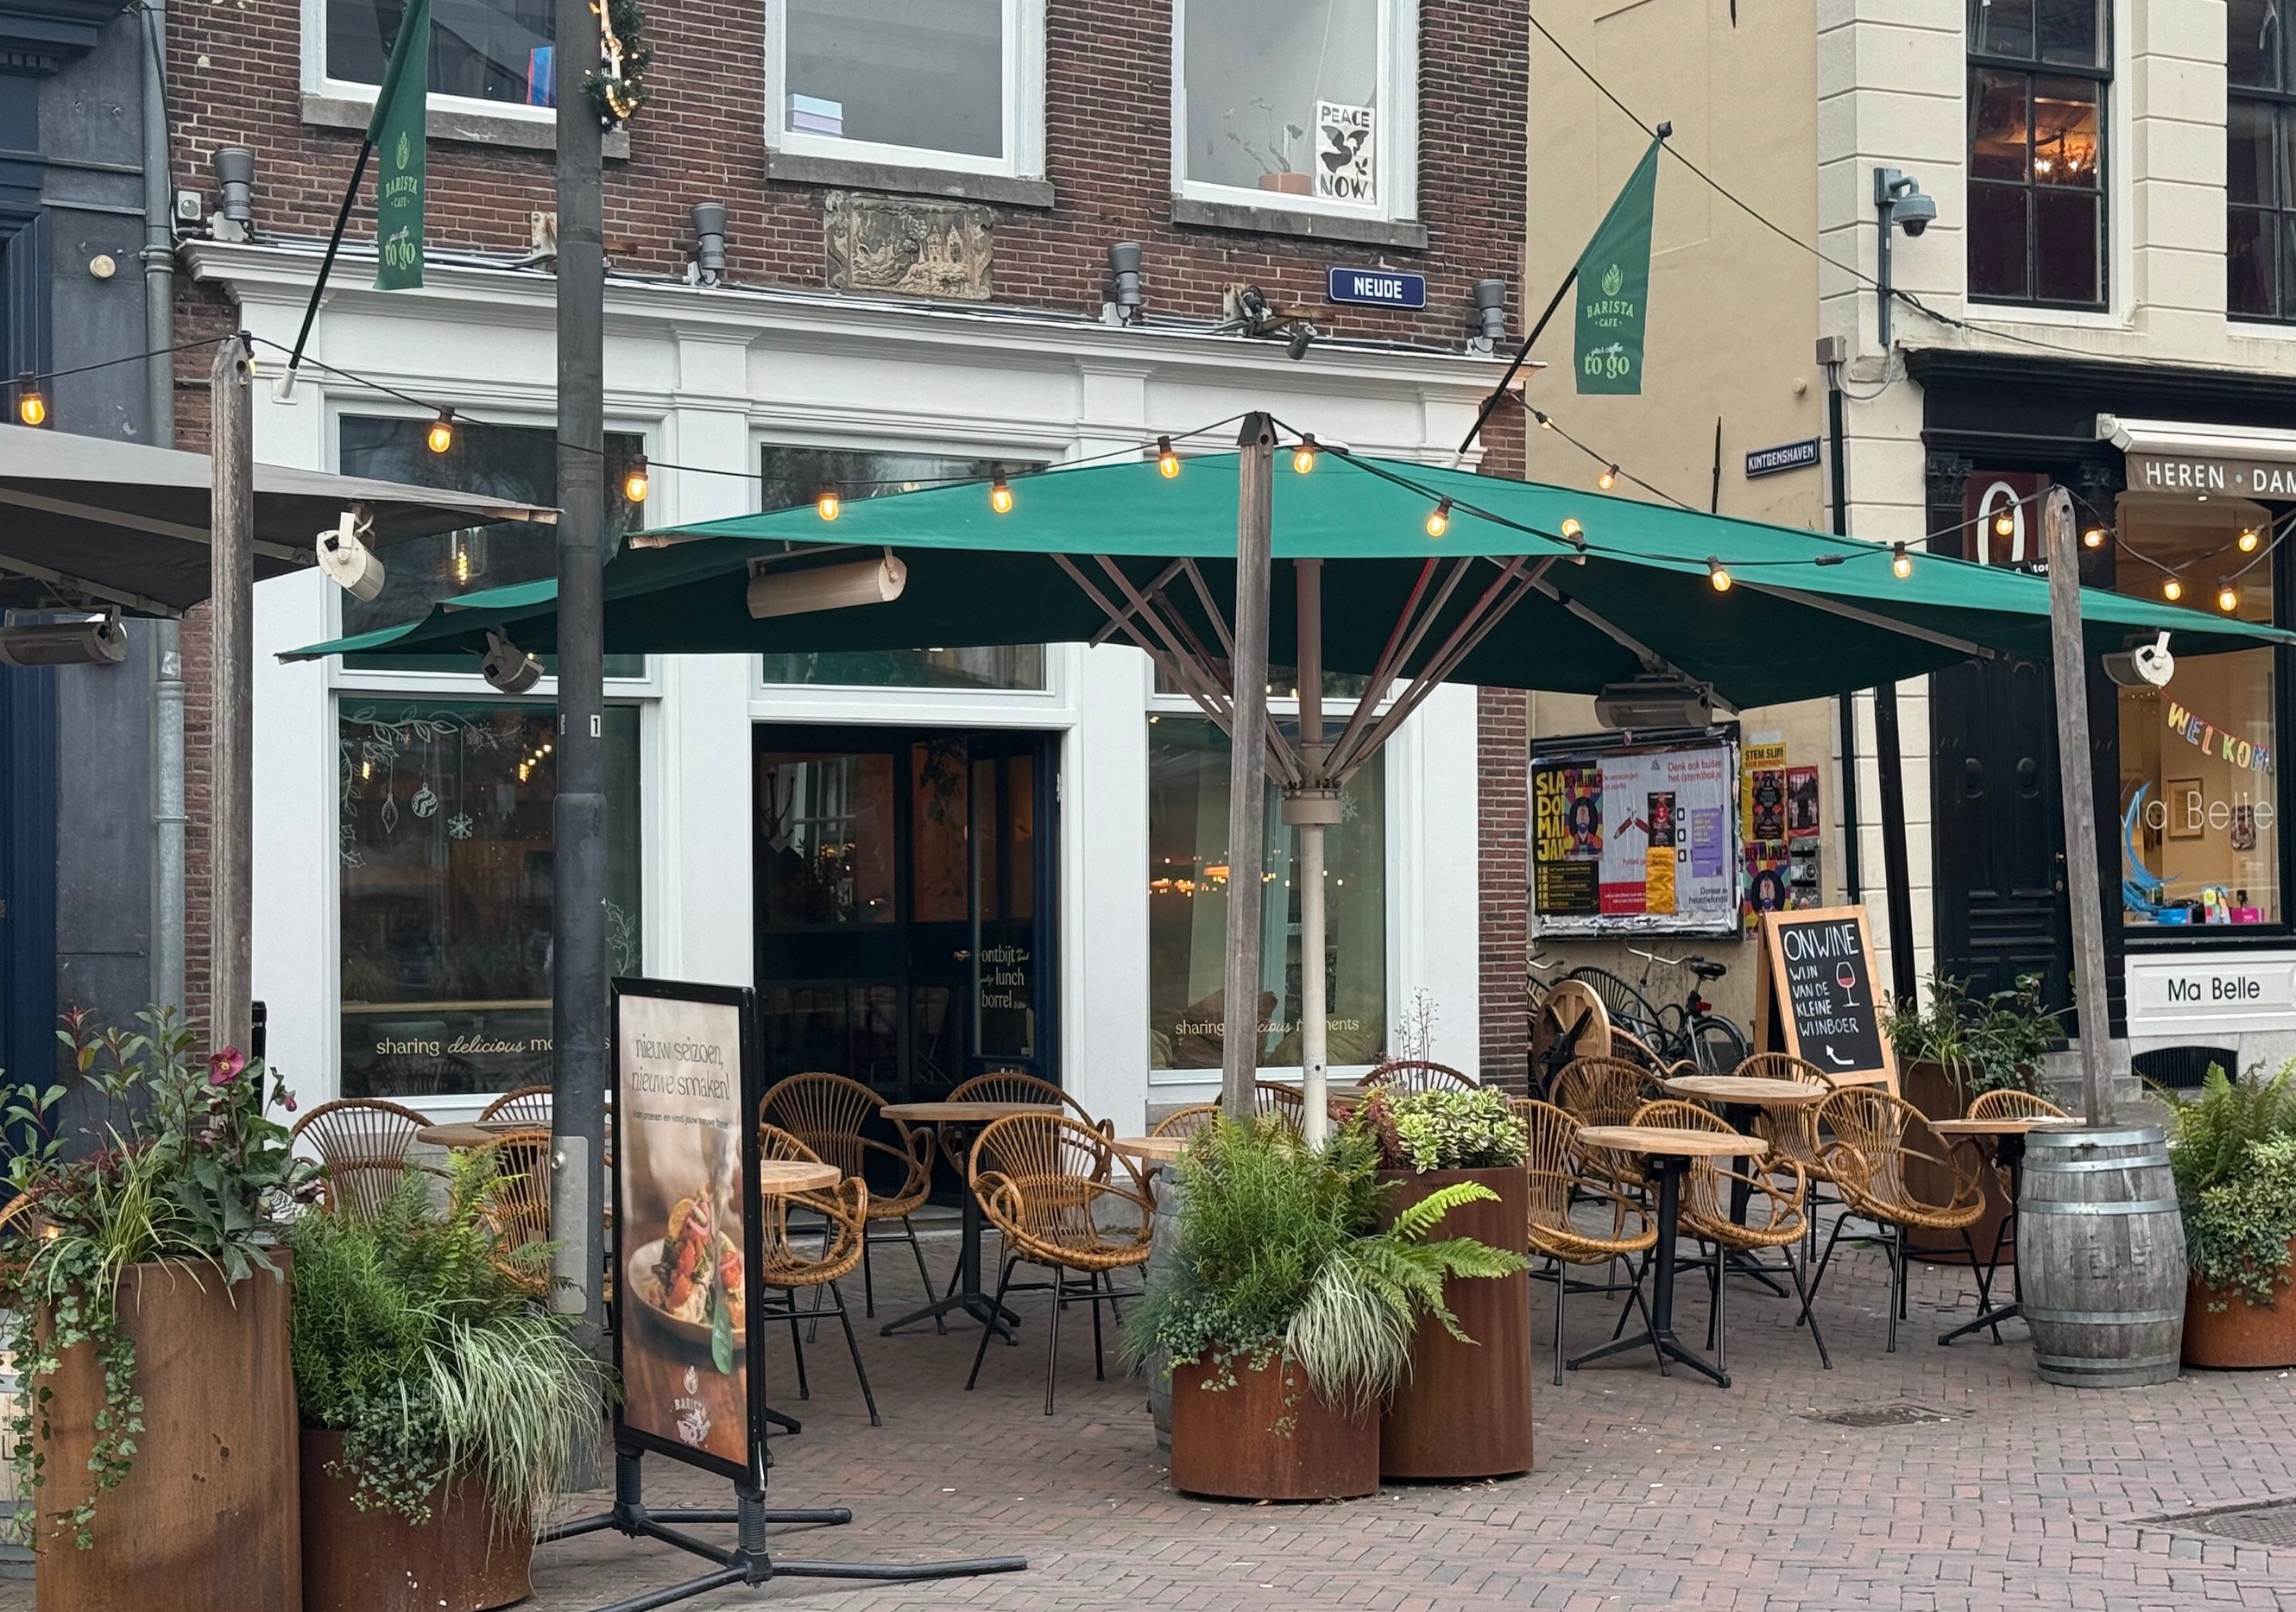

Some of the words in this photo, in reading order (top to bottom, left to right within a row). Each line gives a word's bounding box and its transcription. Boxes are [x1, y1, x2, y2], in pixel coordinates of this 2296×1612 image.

[1321, 105, 1370, 128] PEACE
[385, 175, 419, 199] BARISTA
[1320, 175, 1368, 200] NOW
[385, 240, 396, 266] to
[399, 241, 416, 270] go
[1353, 276, 1403, 300] NEUDE
[1586, 300, 1634, 319] BARISTA
[1599, 318, 1618, 327] CAFE
[1585, 352, 1603, 375] to
[1606, 355, 1630, 379] go
[1748, 444, 1814, 471] KINTGENSHAVEN
[2145, 461, 2224, 489] HEREN
[1745, 749, 1765, 762] STEM
[1766, 747, 1784, 759] SLIM
[1668, 762, 1686, 772] Denk
[1687, 762, 1700, 770] ook
[1668, 773, 1681, 783] het
[2187, 790, 2274, 830] Belle
[1783, 924, 1859, 961] ONWINE
[981, 944, 1015, 966] ontbijt
[995, 966, 1025, 986] lunch
[1789, 964, 1818, 981] WIJN
[981, 989, 1012, 1008] borrel
[1792, 983, 1813, 999] VAN
[1815, 982, 1830, 996] DE
[2168, 978, 2201, 1002] Ma
[2212, 977, 2261, 1001] Belle
[1795, 999, 1832, 1017] KLEINE
[1176, 1019, 1225, 1036] sharing
[1799, 1017, 1859, 1037] WIJNBOER
[375, 1038, 440, 1057] sharing
[447, 1034, 526, 1054] delicious
[635, 1034, 671, 1060] nieuw
[674, 1037, 724, 1070] seizoen,
[631, 1066, 674, 1094] nieuwe
[677, 1070, 730, 1101] smaken!
